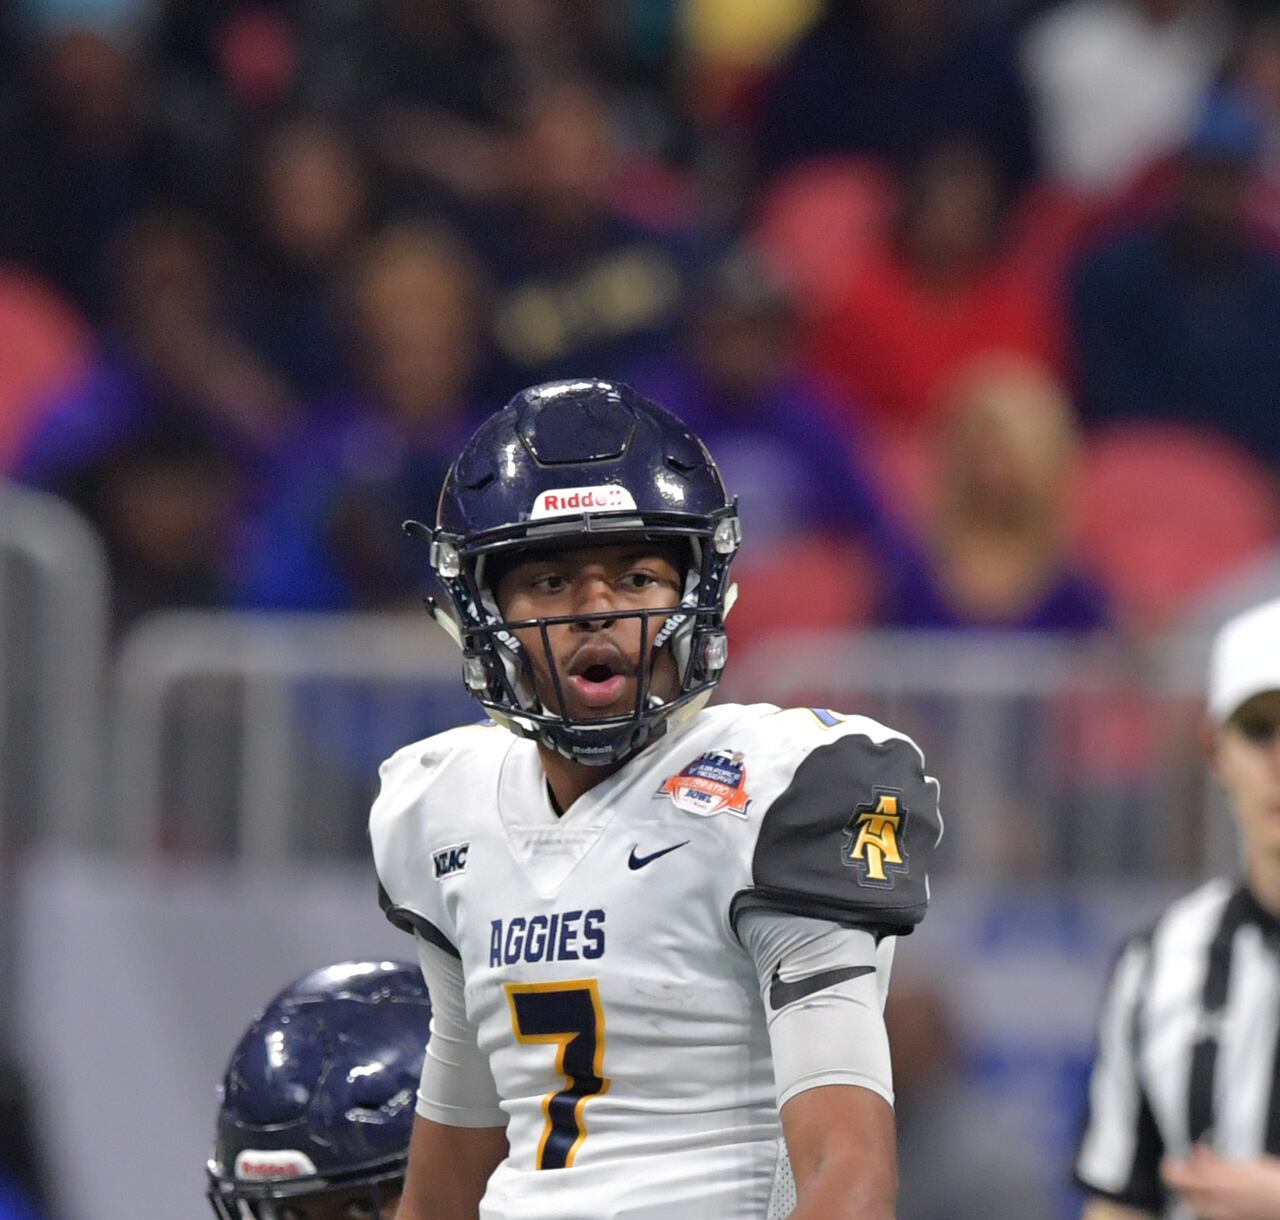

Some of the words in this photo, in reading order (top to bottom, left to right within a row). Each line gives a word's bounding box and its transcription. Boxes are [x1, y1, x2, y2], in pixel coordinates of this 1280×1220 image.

[544, 491, 622, 511] Ridde
[489, 908, 607, 969] AGGIES
[504, 978, 613, 1171] 7
